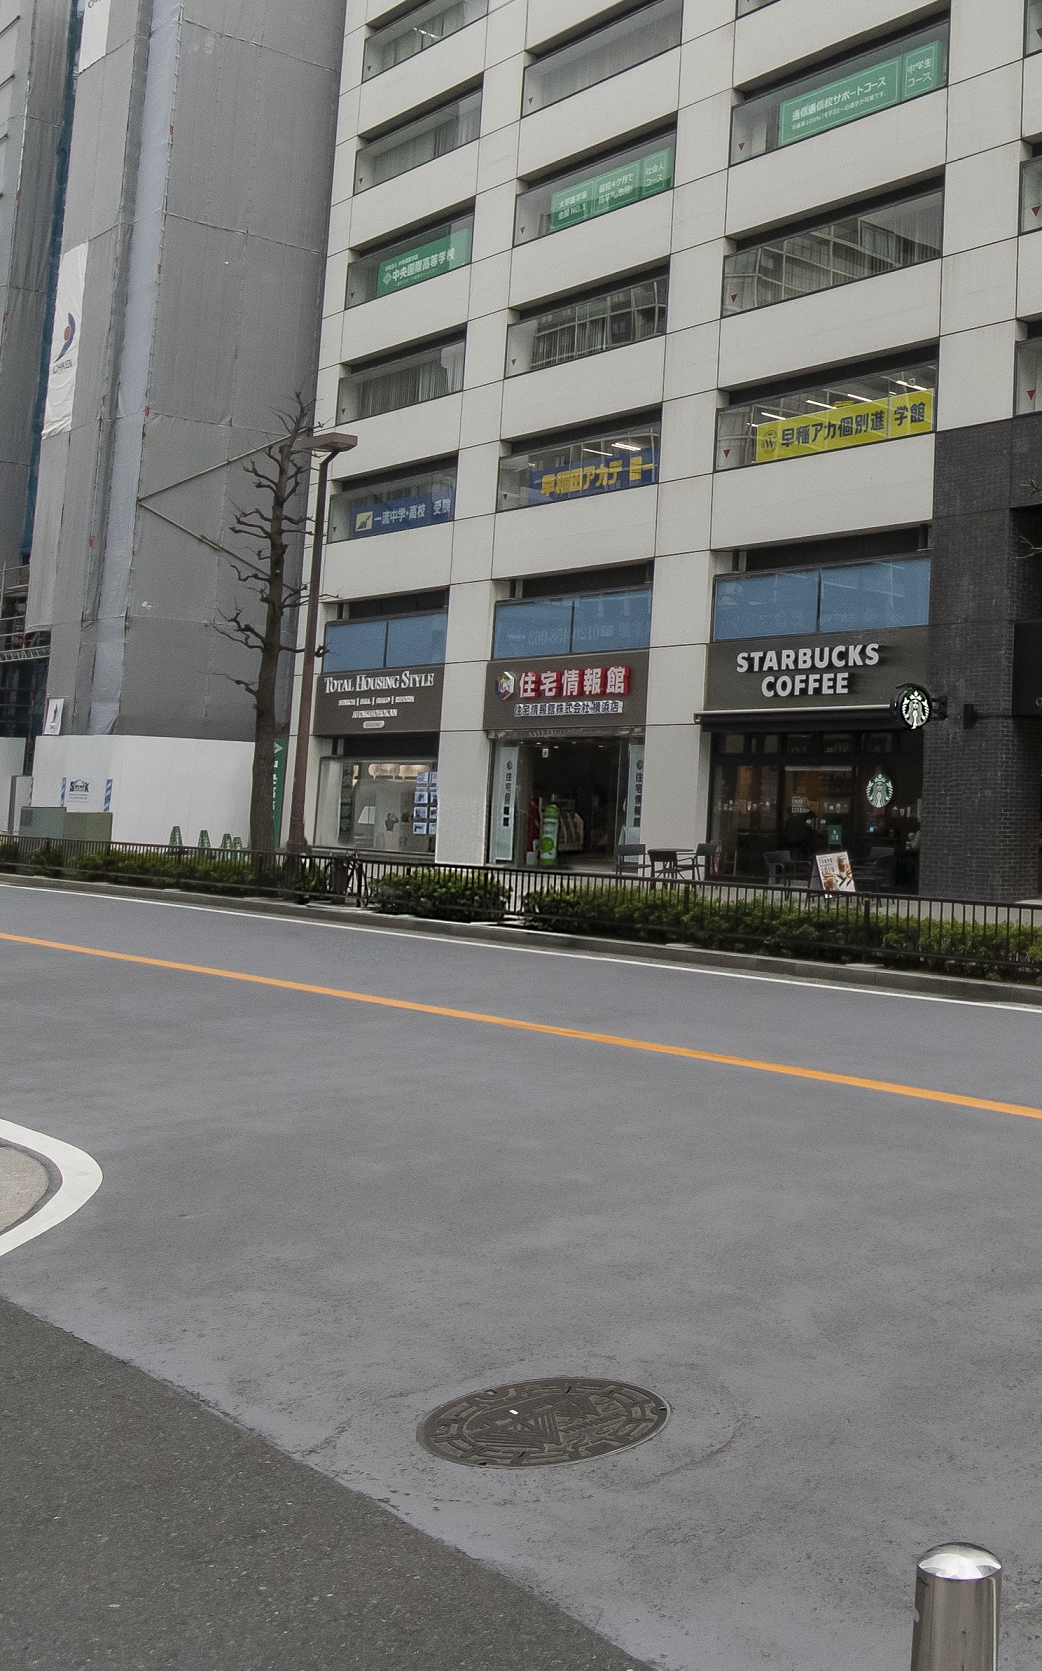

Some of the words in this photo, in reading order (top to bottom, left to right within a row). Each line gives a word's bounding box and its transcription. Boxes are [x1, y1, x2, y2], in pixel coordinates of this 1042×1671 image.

[907, 72, 932, 88] コース
[645, 174, 663, 187] コース
[736, 643, 879, 672] STARBUCKS
[324, 677, 354, 693] TOTAL
[355, 674, 400, 692] HOUSING
[401, 670, 435, 689] STYLE
[519, 666, 627, 698] 住宅情報館
[761, 672, 849, 698] COFFEE
